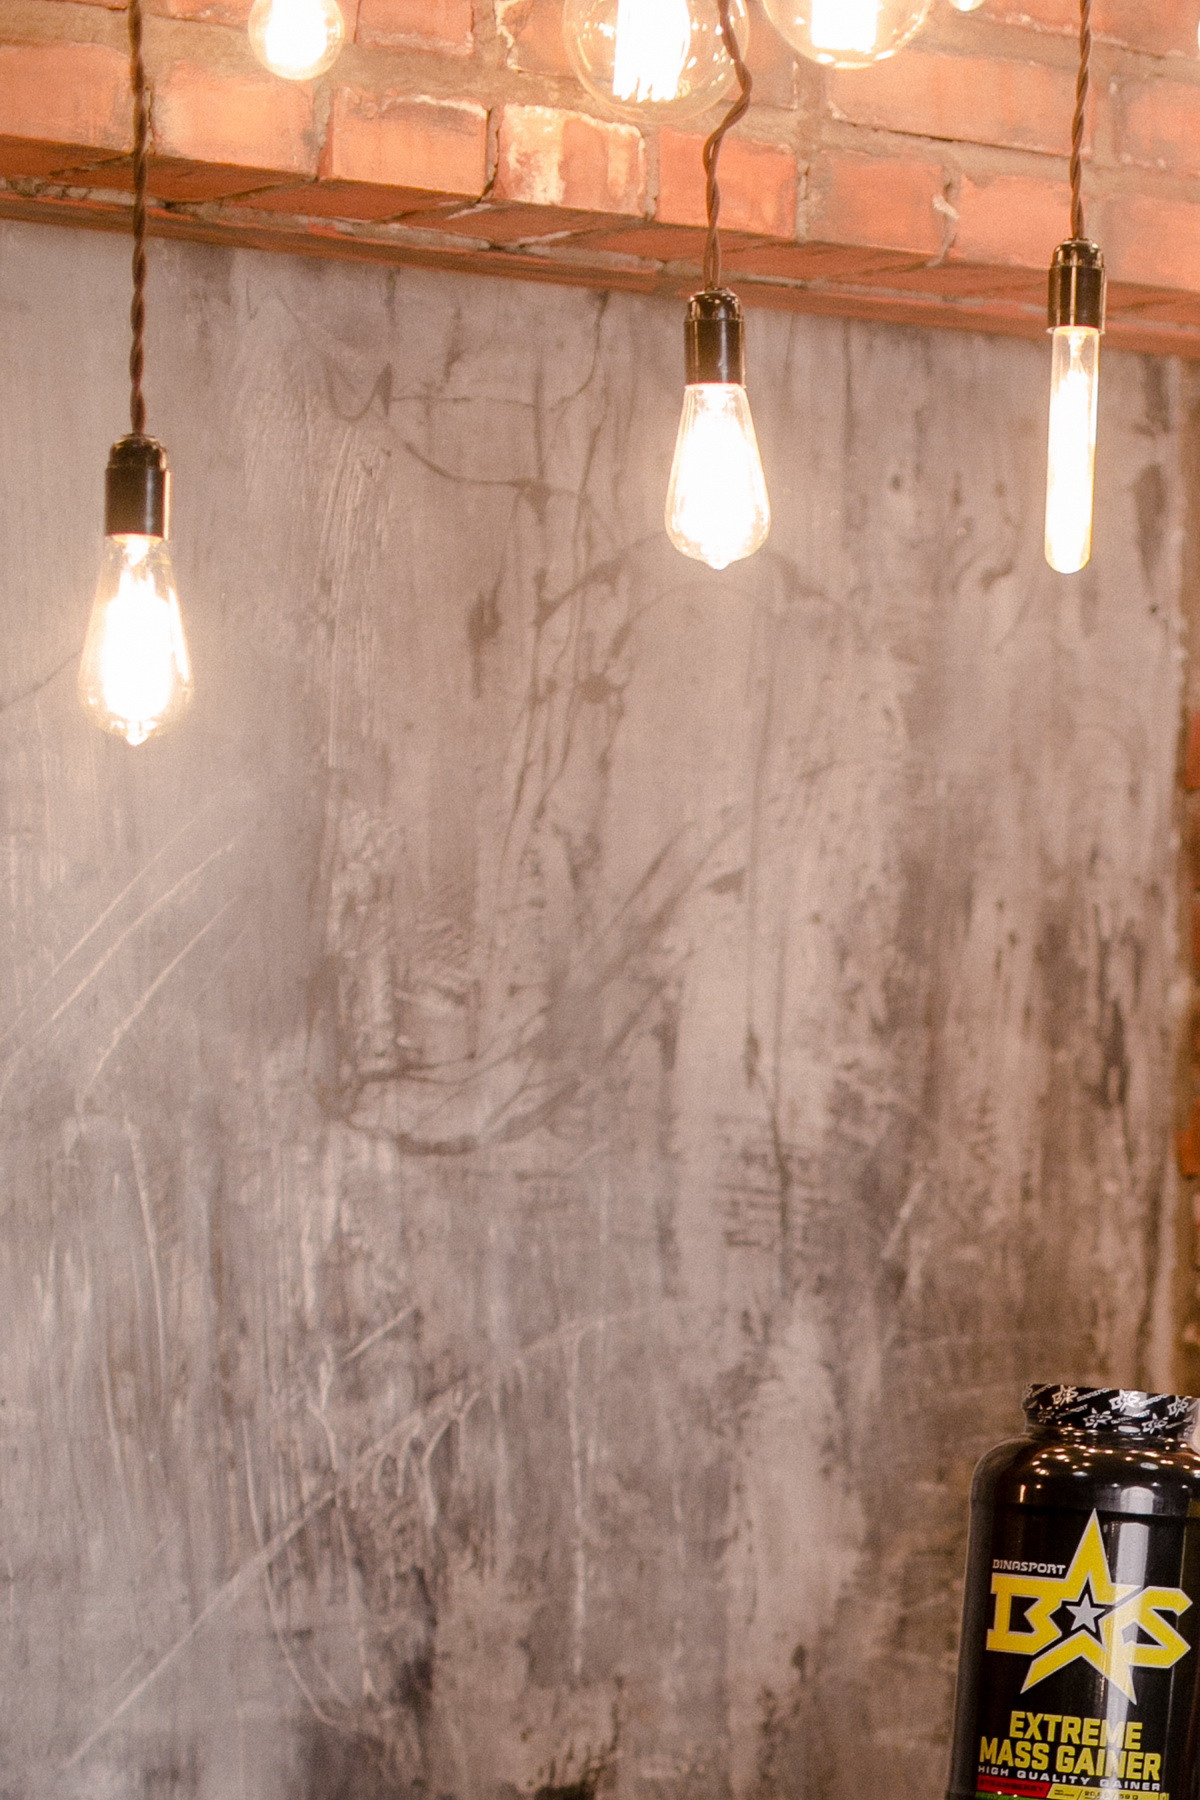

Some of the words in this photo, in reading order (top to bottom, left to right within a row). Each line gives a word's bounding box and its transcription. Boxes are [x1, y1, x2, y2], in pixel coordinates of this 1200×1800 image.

[992, 1559, 1066, 1575] BINASPORT
[1009, 1710, 1143, 1750] EXTREME
[979, 1736, 1049, 1771] MASS
[1055, 1745, 1161, 1781] GAINER
[978, 1765, 1009, 1777] HIGH
[1017, 1770, 1090, 1786] QUALITY
[1100, 1778, 1161, 1791] GAINER
